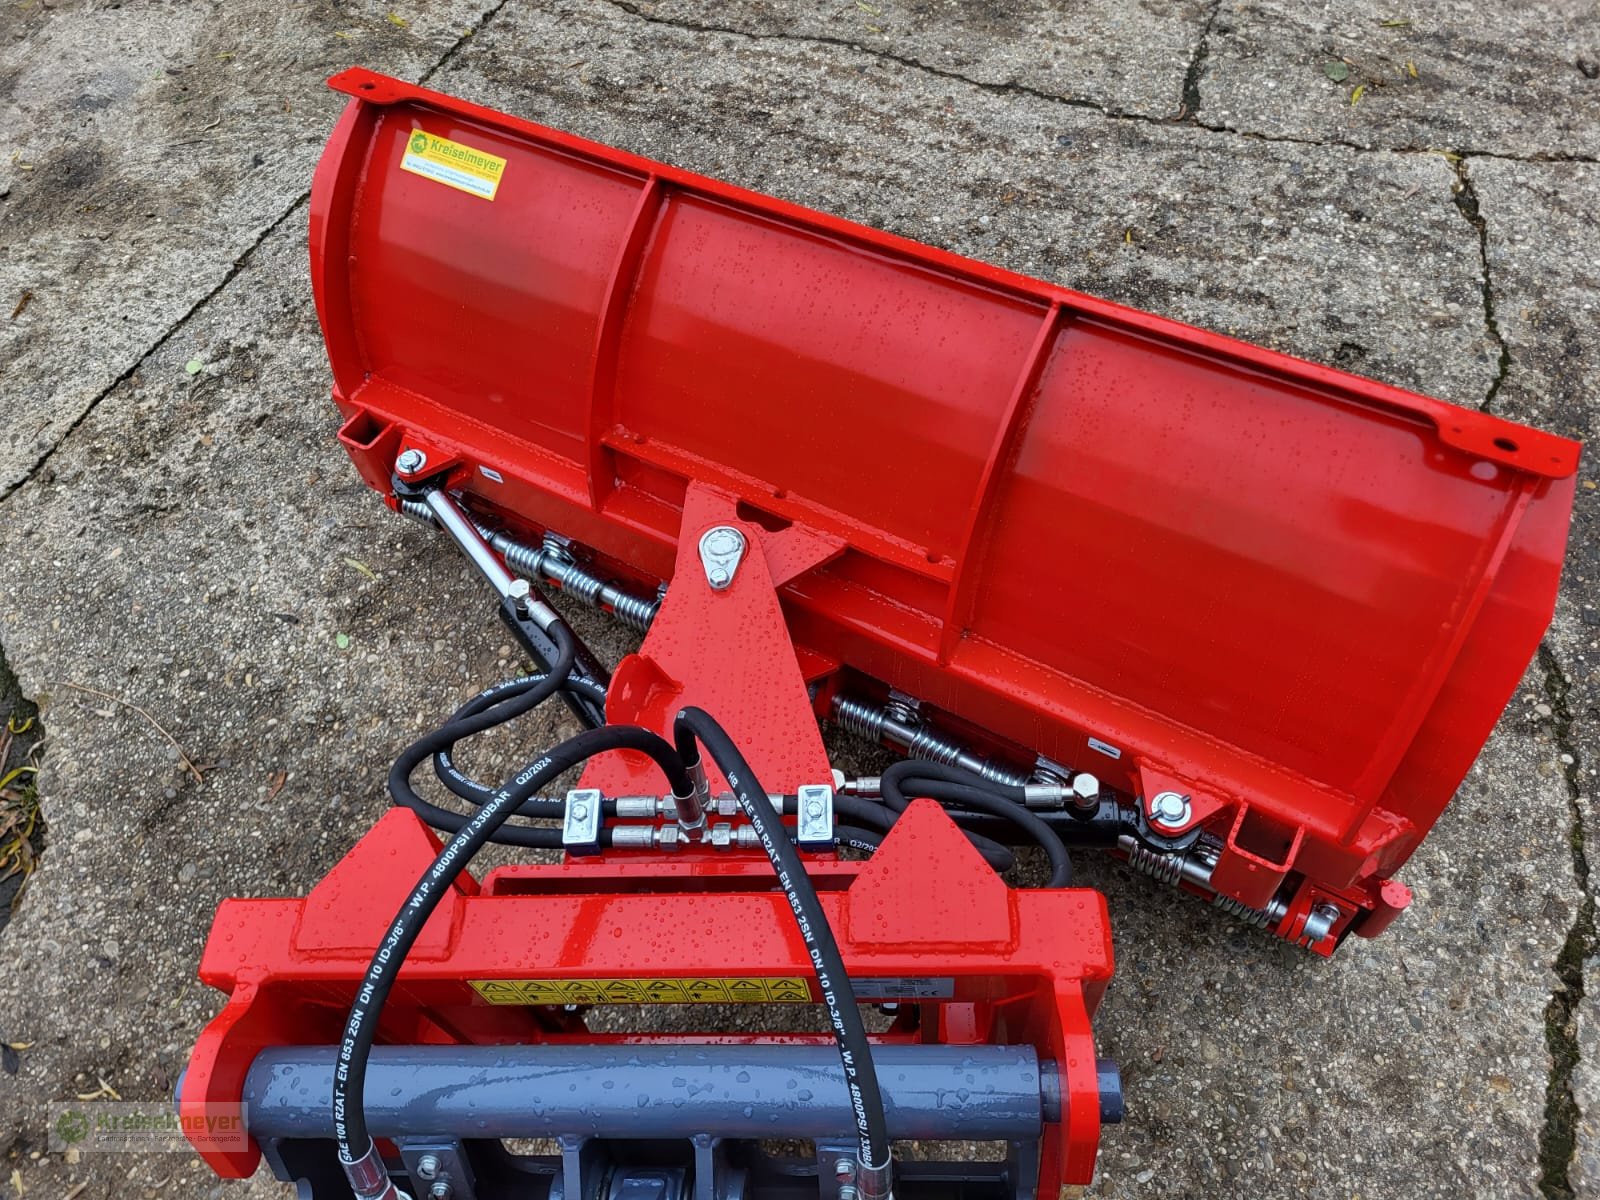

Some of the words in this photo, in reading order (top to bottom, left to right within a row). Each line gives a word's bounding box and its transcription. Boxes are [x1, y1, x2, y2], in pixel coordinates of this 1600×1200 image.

[430, 139, 502, 172] Kreiselmeyer
[515, 757, 552, 785] Q2/2024
[471, 790, 511, 829] 330BAR
[432, 832, 470, 880] 4800PSI
[409, 879, 435, 910] W.P.
[727, 771, 739, 790] HB
[739, 792, 754, 817] SAE
[752, 815, 764, 834] 100
[761, 834, 781, 866] R2AT
[778, 872, 792, 892] EN
[787, 891, 802, 915] 853
[797, 915, 814, 943] 2SN
[810, 949, 825, 970] DN
[819, 973, 831, 989] 10
[842, 1051, 856, 1080] W.P.
[849, 1083, 868, 1130] 4800PSI
[369, 964, 383, 980] 10
[360, 983, 375, 1005] DN
[348, 1009, 364, 1037] 2SN
[341, 1039, 355, 1061] 853
[337, 1062, 348, 1082] EN
[335, 1090, 346, 1121] R2AT
[336, 1122, 346, 1140] 100
[338, 1140, 352, 1161] SAE
